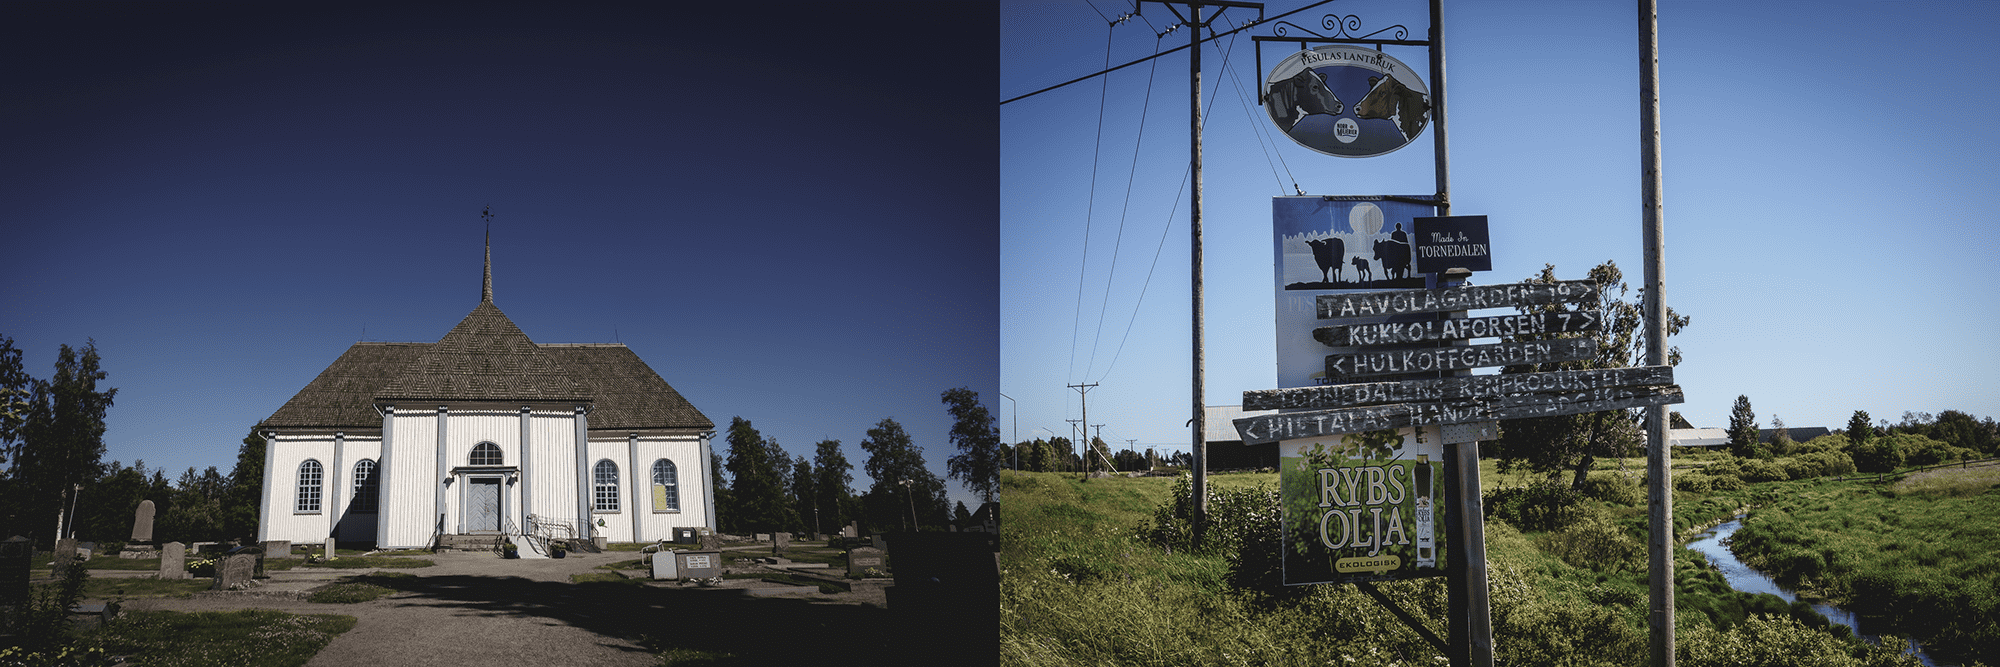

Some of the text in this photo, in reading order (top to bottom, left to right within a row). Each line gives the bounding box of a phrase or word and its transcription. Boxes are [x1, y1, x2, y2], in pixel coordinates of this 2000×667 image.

[1301, 52, 1396, 72] PESULAS LANTBRUK
[1431, 231, 1469, 243] Made In
[1419, 244, 1487, 258] TORNEDALEN
[1350, 314, 1571, 346] KUKKOLAFORSEN 7
[1319, 465, 1406, 508] RYBS
[1320, 507, 1410, 557] OLJA
[1340, 559, 1397, 569] EKOLOGISK
